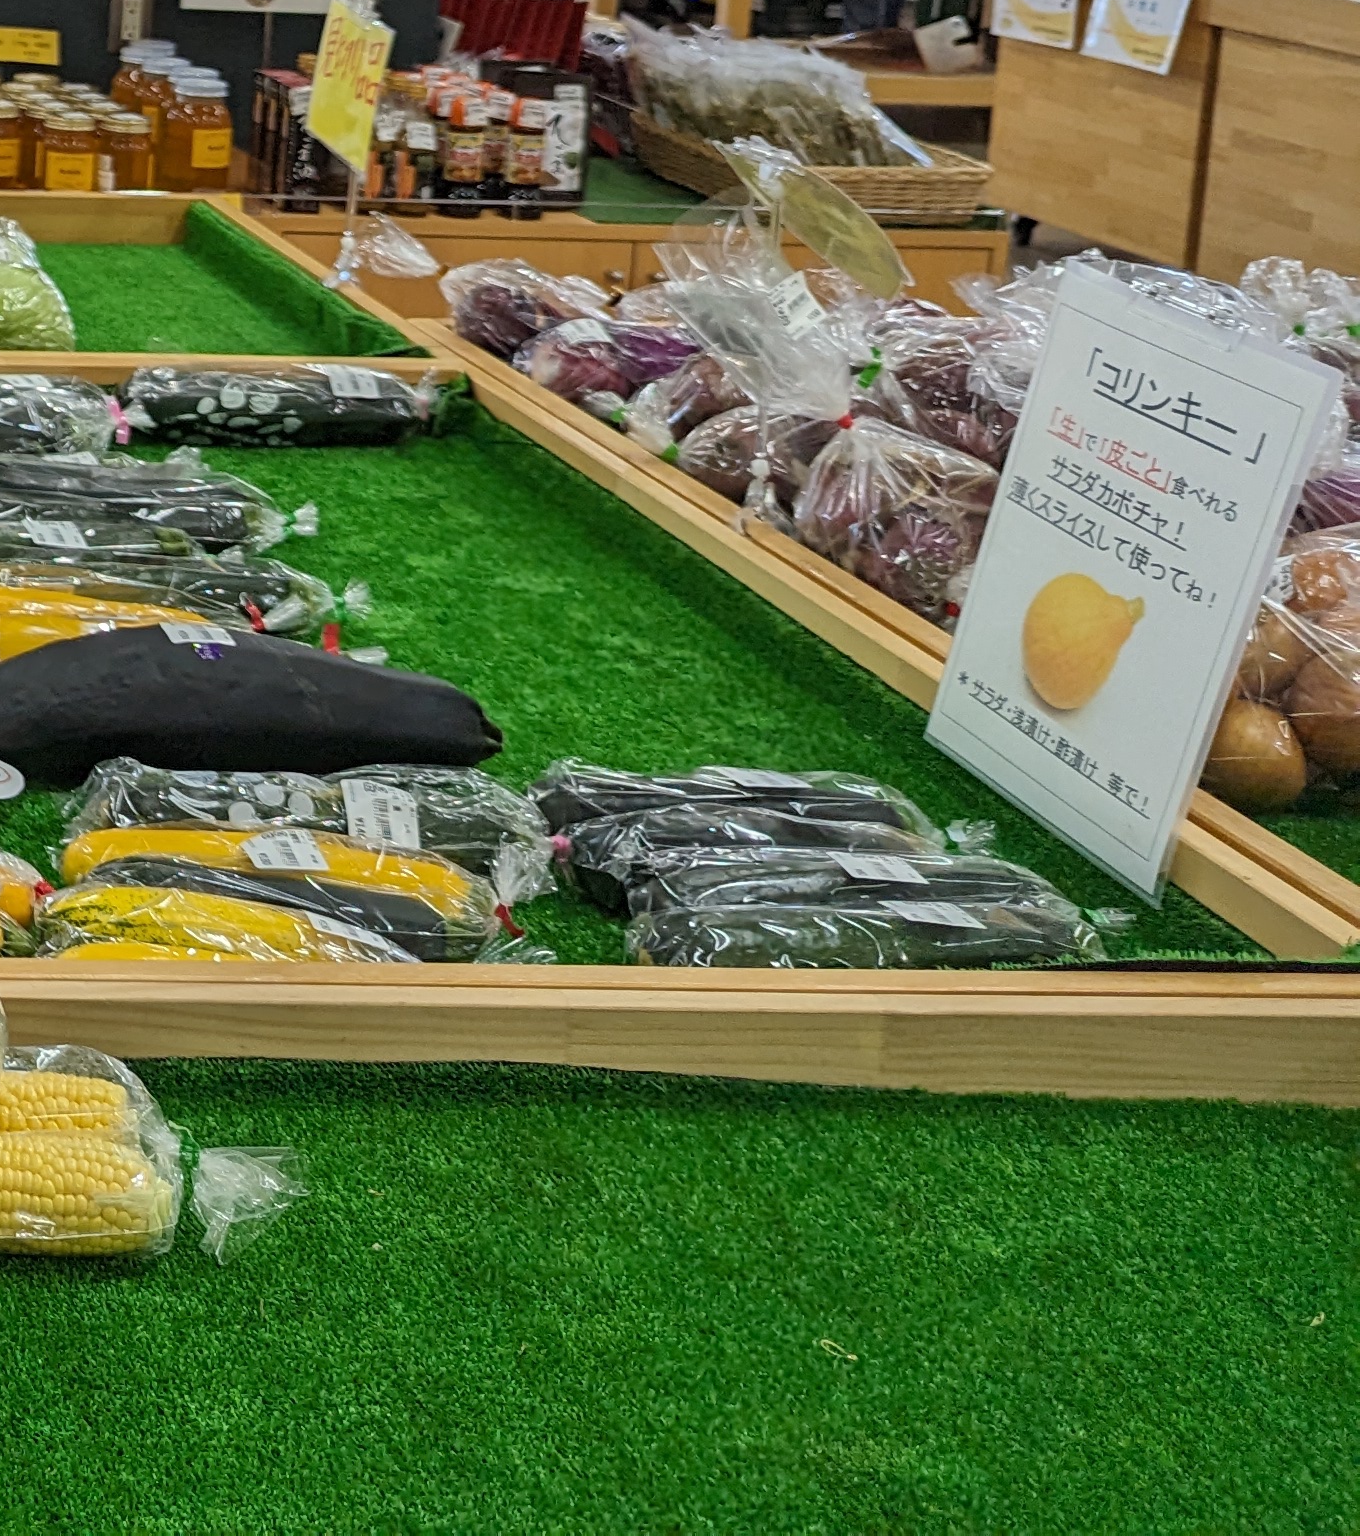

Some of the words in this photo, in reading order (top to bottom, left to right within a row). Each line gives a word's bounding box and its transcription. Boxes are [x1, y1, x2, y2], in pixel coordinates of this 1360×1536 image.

[1086, 347, 1267, 464] 「コリンキー」
[1047, 407, 1239, 523] 「生」で「皮ごと」食べれる
[1049, 454, 1186, 546] サラダカボチャ！
[1007, 475, 1218, 609] 薄くスライスして使ってね！
